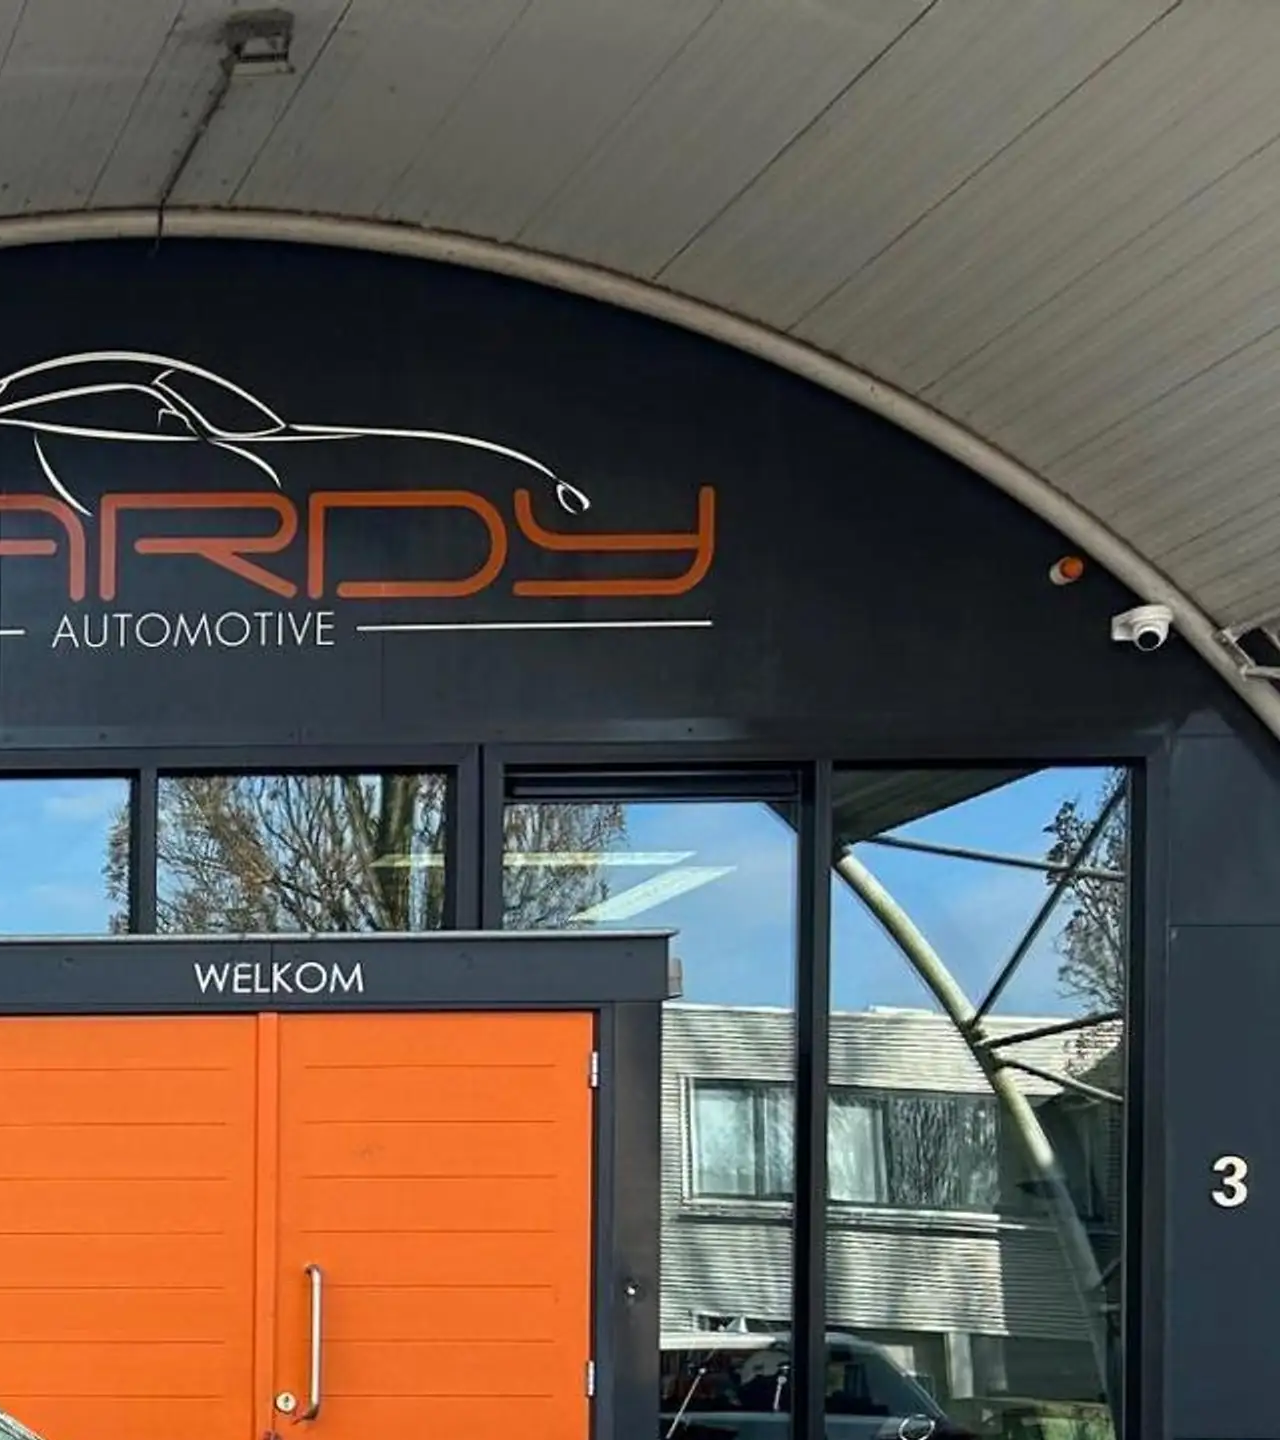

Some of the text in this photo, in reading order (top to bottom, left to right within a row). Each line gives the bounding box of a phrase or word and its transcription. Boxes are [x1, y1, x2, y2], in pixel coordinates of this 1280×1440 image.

[51, 611, 336, 648] AUTOMOTIVE
[194, 961, 365, 994] WELKOM
[1211, 1155, 1249, 1208] 3
